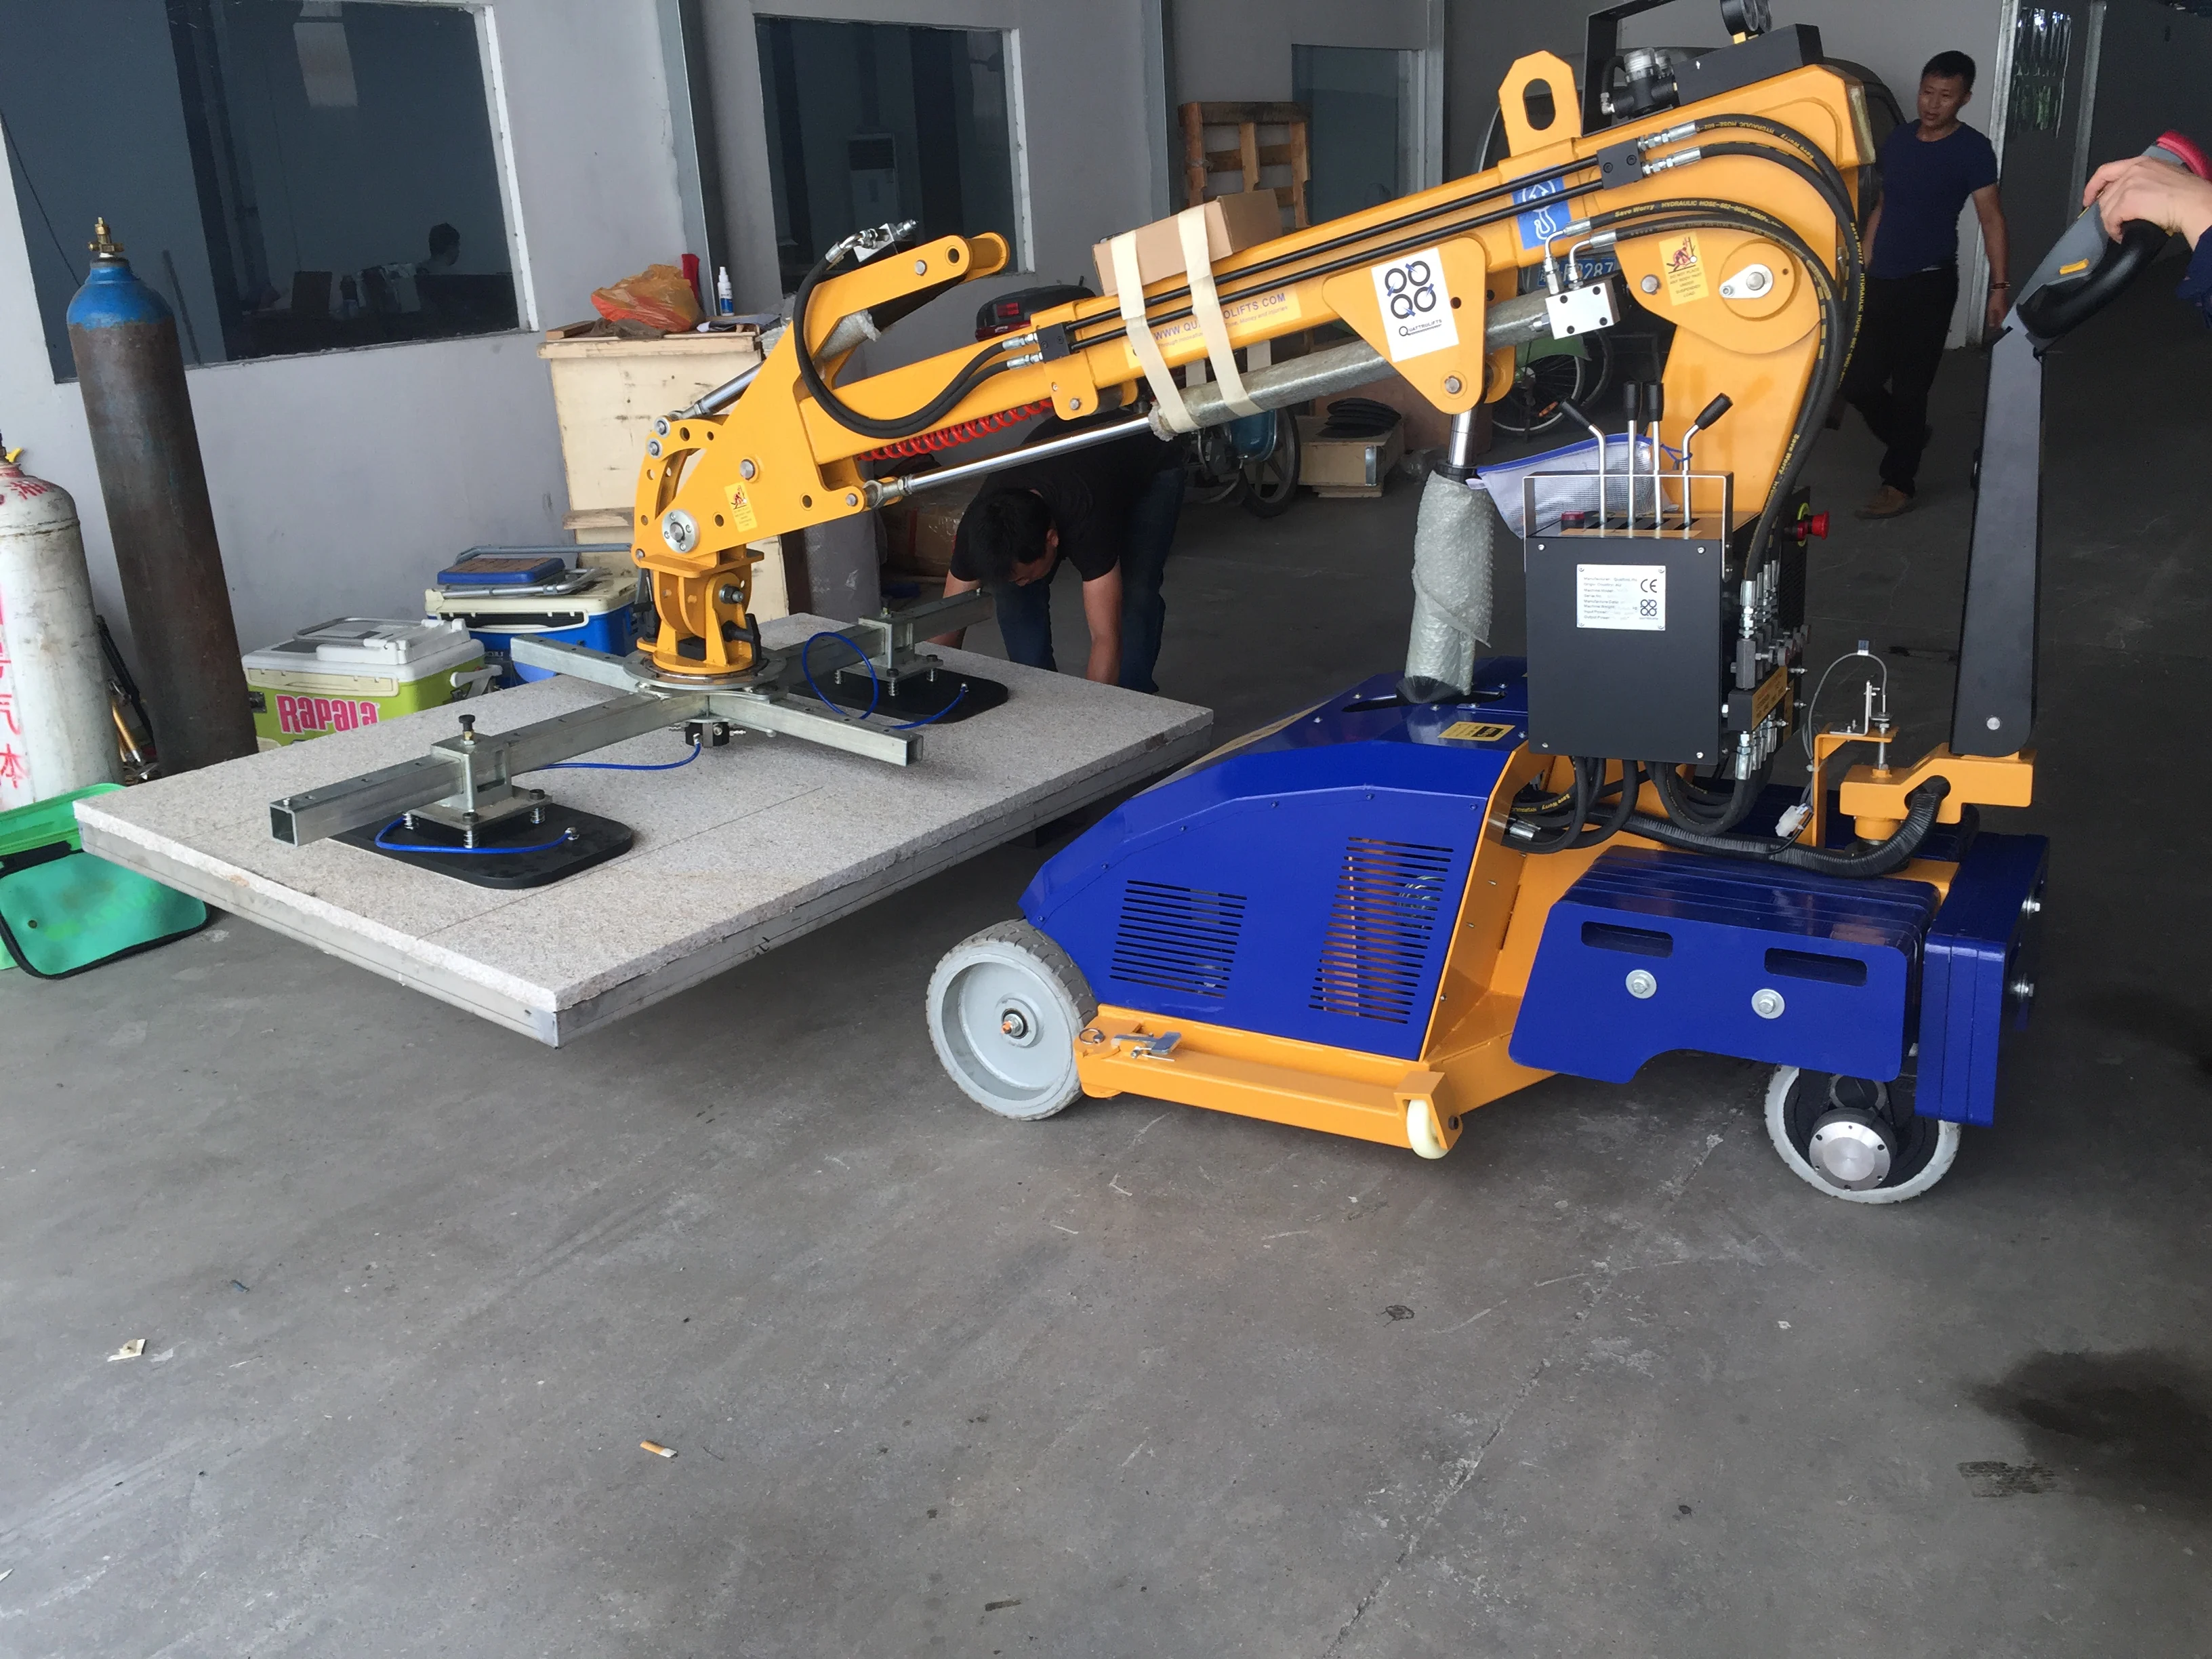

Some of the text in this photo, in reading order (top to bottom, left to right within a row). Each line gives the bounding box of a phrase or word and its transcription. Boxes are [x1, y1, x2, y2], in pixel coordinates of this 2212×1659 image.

[1739, 122, 1775, 134] HYDRAULIC
[1780, 134, 1799, 148] Worry
[1615, 209, 1632, 218] Save
[1661, 200, 1698, 208] HYDRAULIC
[1858, 272, 1866, 312] HYDRAULIC
[275, 694, 379, 734] Rapala
